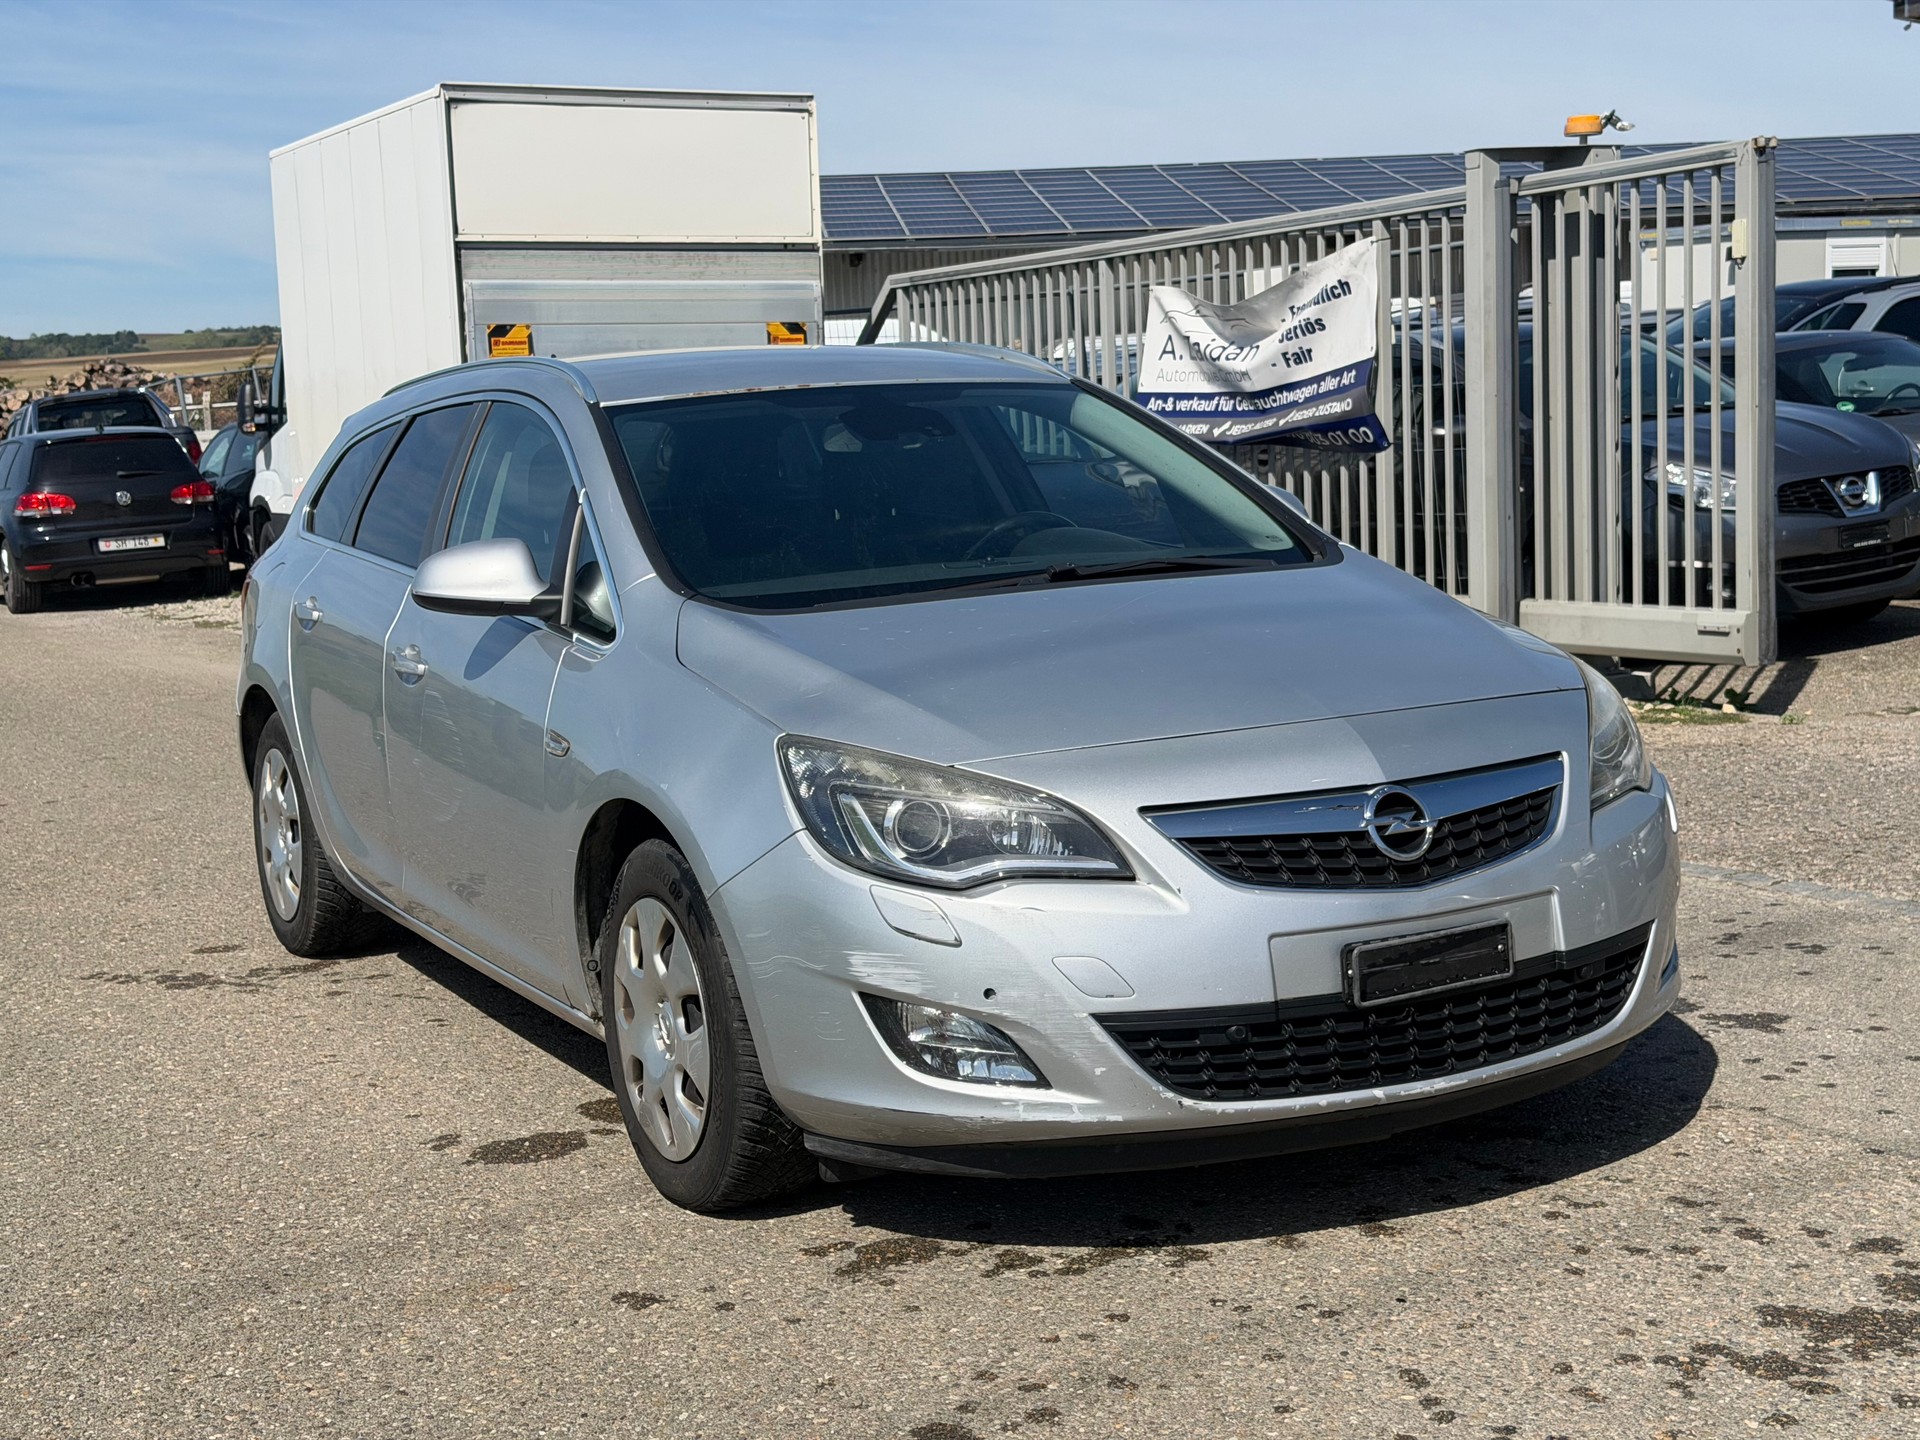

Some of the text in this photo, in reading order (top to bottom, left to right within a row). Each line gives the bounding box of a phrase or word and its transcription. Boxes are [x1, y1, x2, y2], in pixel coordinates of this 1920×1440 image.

[1281, 346, 1313, 368] Fair
[1175, 396, 1219, 411] verkauf
[1217, 396, 1234, 411] für
[1235, 384, 1317, 411] Gebauchtwagen
[1319, 375, 1341, 394] aller
[1340, 369, 1356, 388] Art
[1313, 398, 1353, 417] ZUSTAND
[1347, 426, 1374, 444] 00
